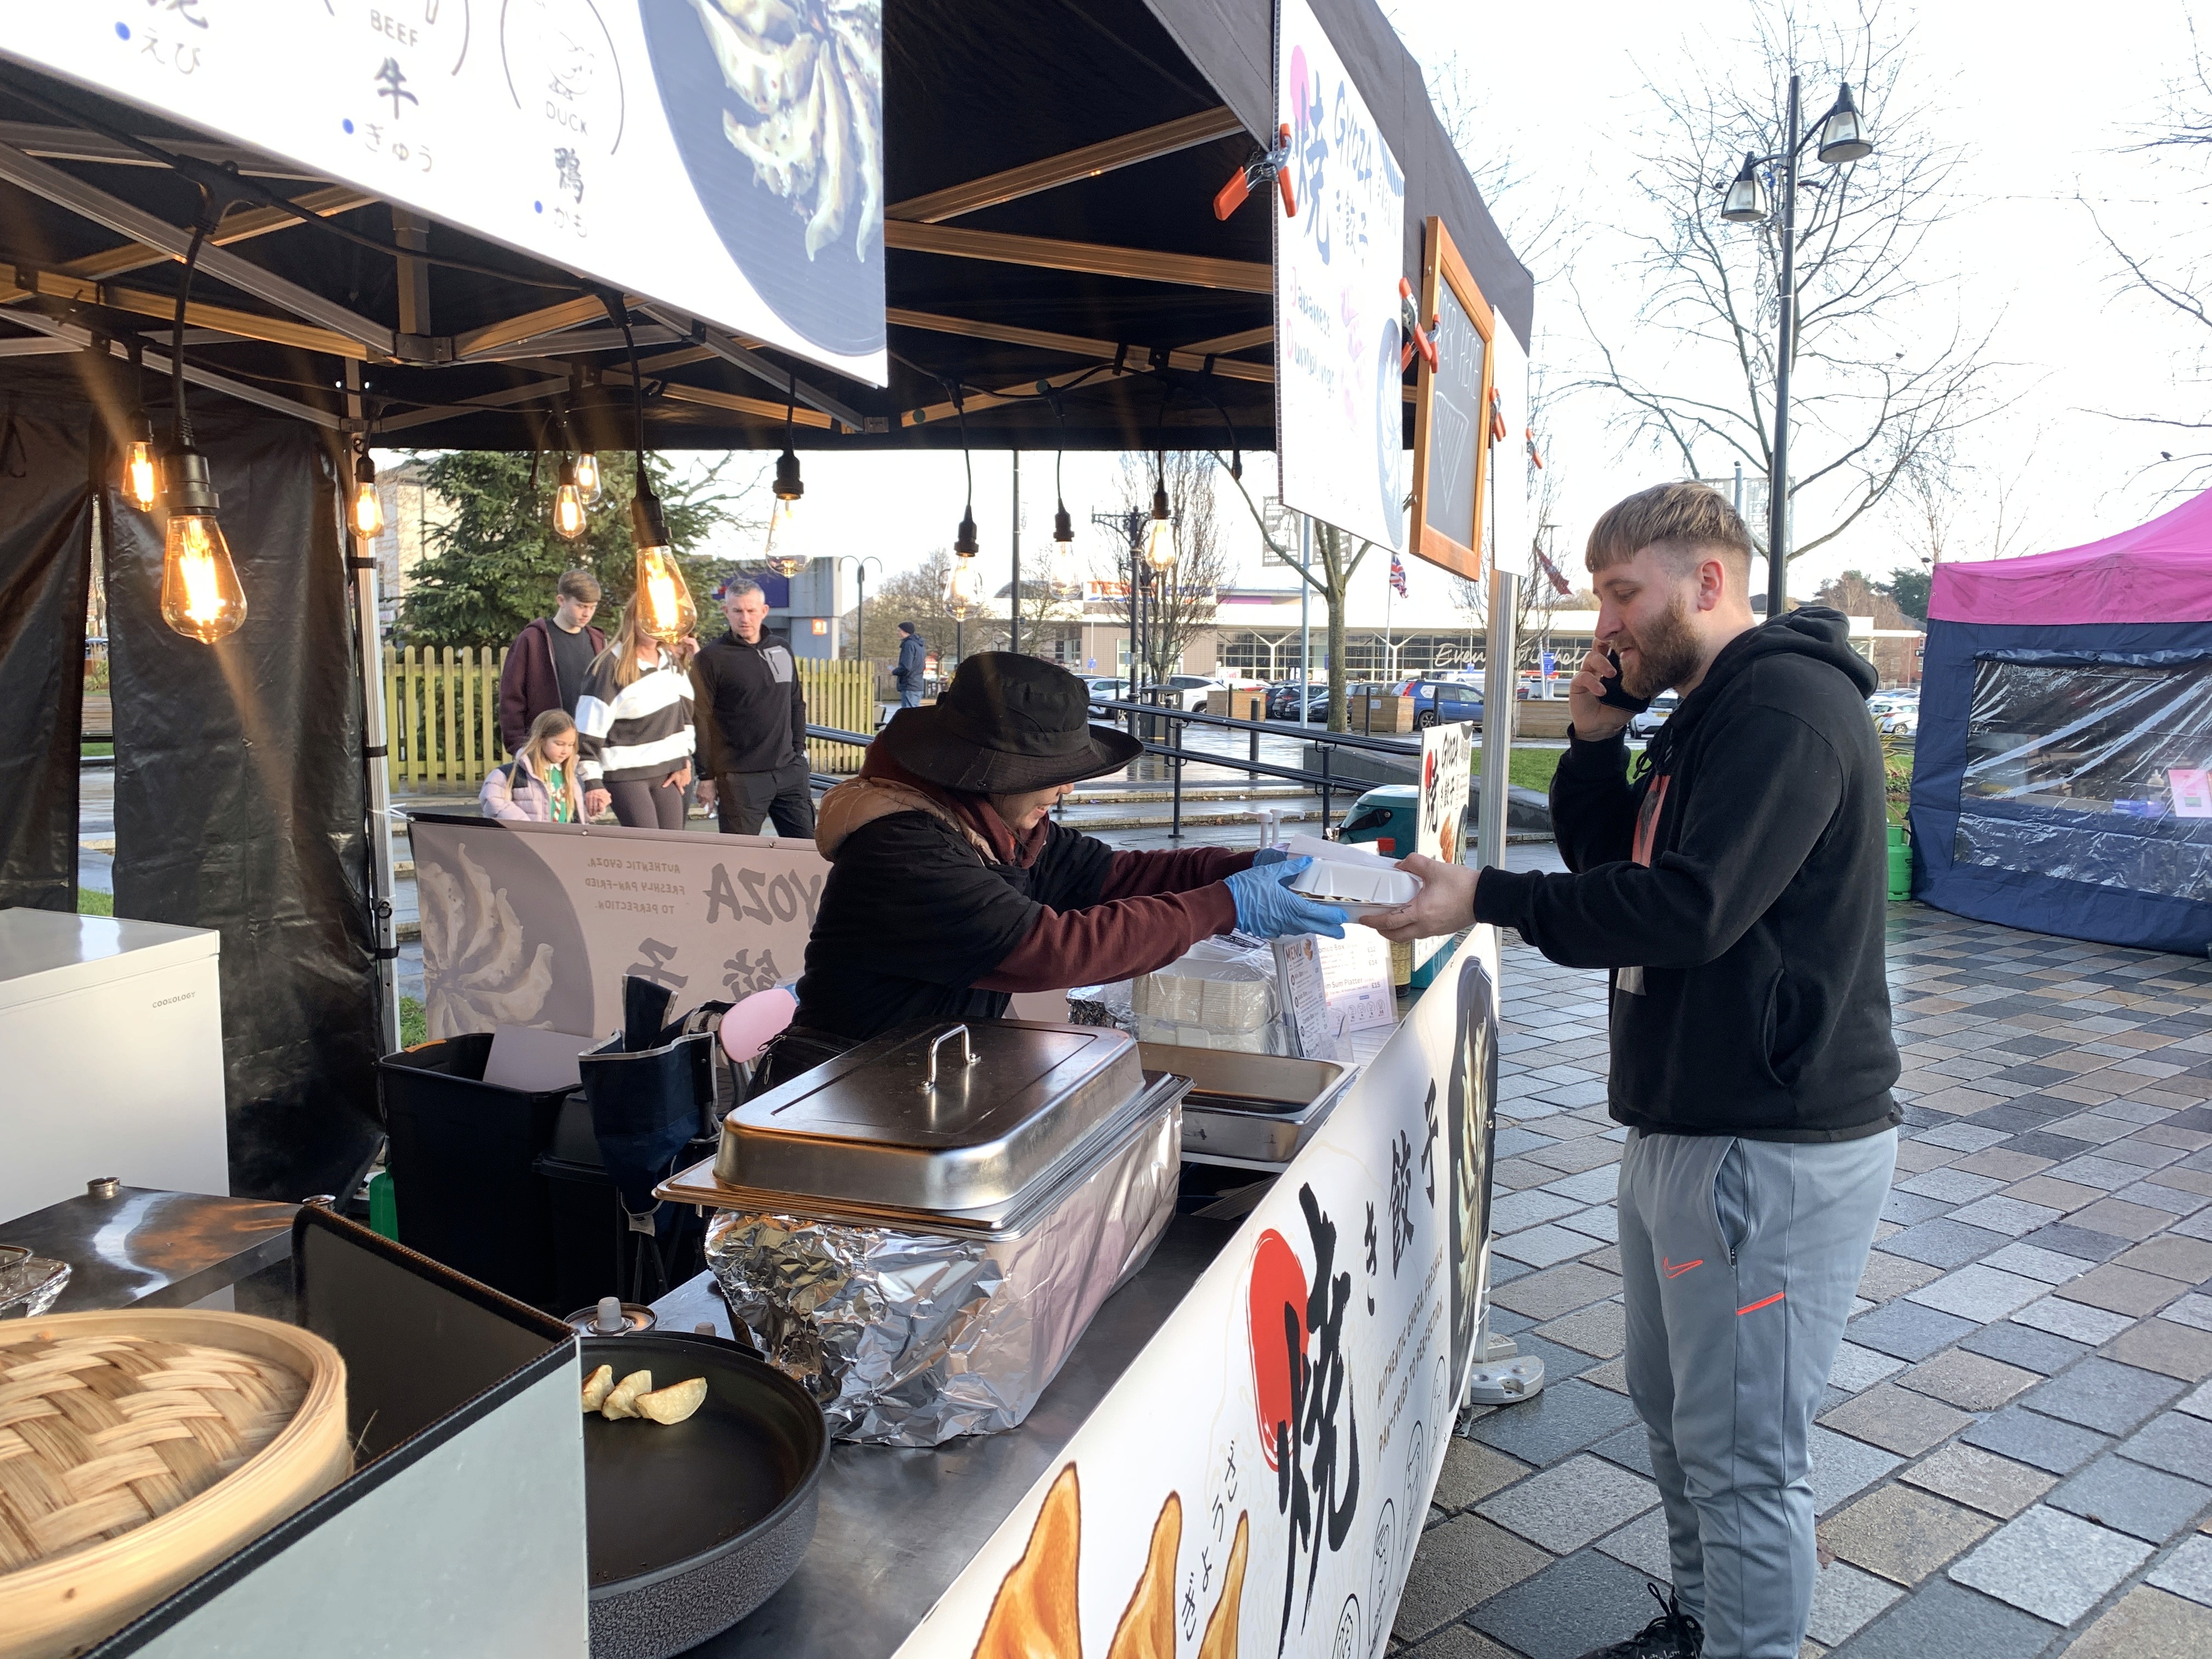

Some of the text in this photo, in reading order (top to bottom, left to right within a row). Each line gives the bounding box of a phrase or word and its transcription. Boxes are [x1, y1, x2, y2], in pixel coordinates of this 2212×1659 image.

[141, 27, 201, 75] えび
[370, 9, 418, 47] BEEF
[374, 57, 419, 120] 牛
[546, 100, 588, 136] DUCK
[1334, 80, 1372, 205] GYOZA
[364, 122, 432, 172] ぎゅう
[554, 148, 584, 204] 鴨
[554, 206, 587, 238] かも
[1458, 323, 1480, 399] HERE
[1442, 731, 1458, 776] GYOZA
[1285, 943, 1302, 963] MENU
[153, 991, 195, 1008] COOKOLOGY
[1344, 978, 1363, 986] Platter
[1378, 1244, 1443, 1409] AUTHENTIC GYOZA, FRESHLY
[1379, 1295, 1444, 1463] PAN-FRIED TO PERFECTION.
[1277, 1181, 1359, 1659] 焼
[1182, 1440, 1238, 1641] ぎょうざ
